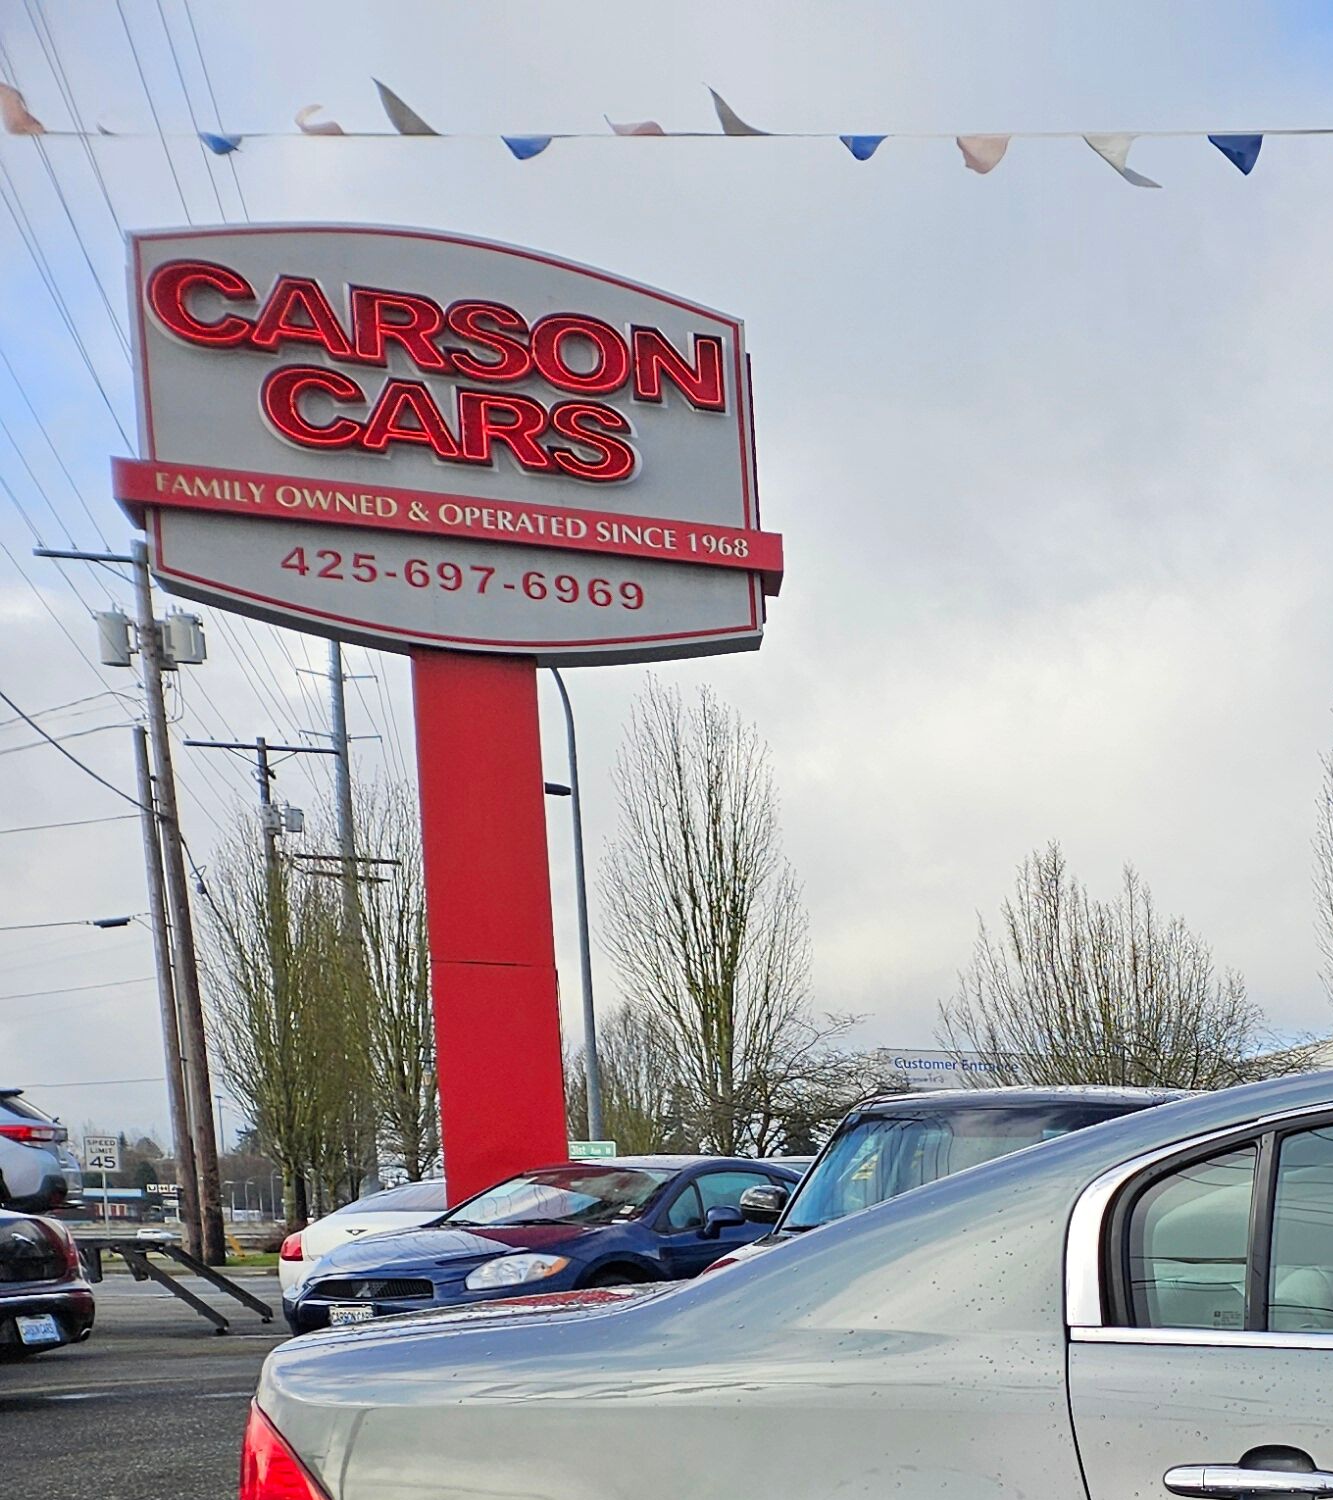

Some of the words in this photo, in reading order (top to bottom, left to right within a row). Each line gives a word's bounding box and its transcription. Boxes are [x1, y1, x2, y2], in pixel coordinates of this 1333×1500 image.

[146, 259, 726, 413] CARSON
[259, 363, 637, 483] CARS
[155, 471, 265, 504] FAMILY
[275, 485, 398, 519] OWNED
[408, 502, 430, 522] &
[438, 504, 590, 541] OPERATED
[596, 520, 678, 551] SINCE
[687, 531, 750, 559] 1968
[280, 545, 645, 611] 425-697-6969
[894, 1057, 957, 1071] Customer
[87, 1139, 116, 1147] SPEED
[89, 1156, 116, 1169] 45
